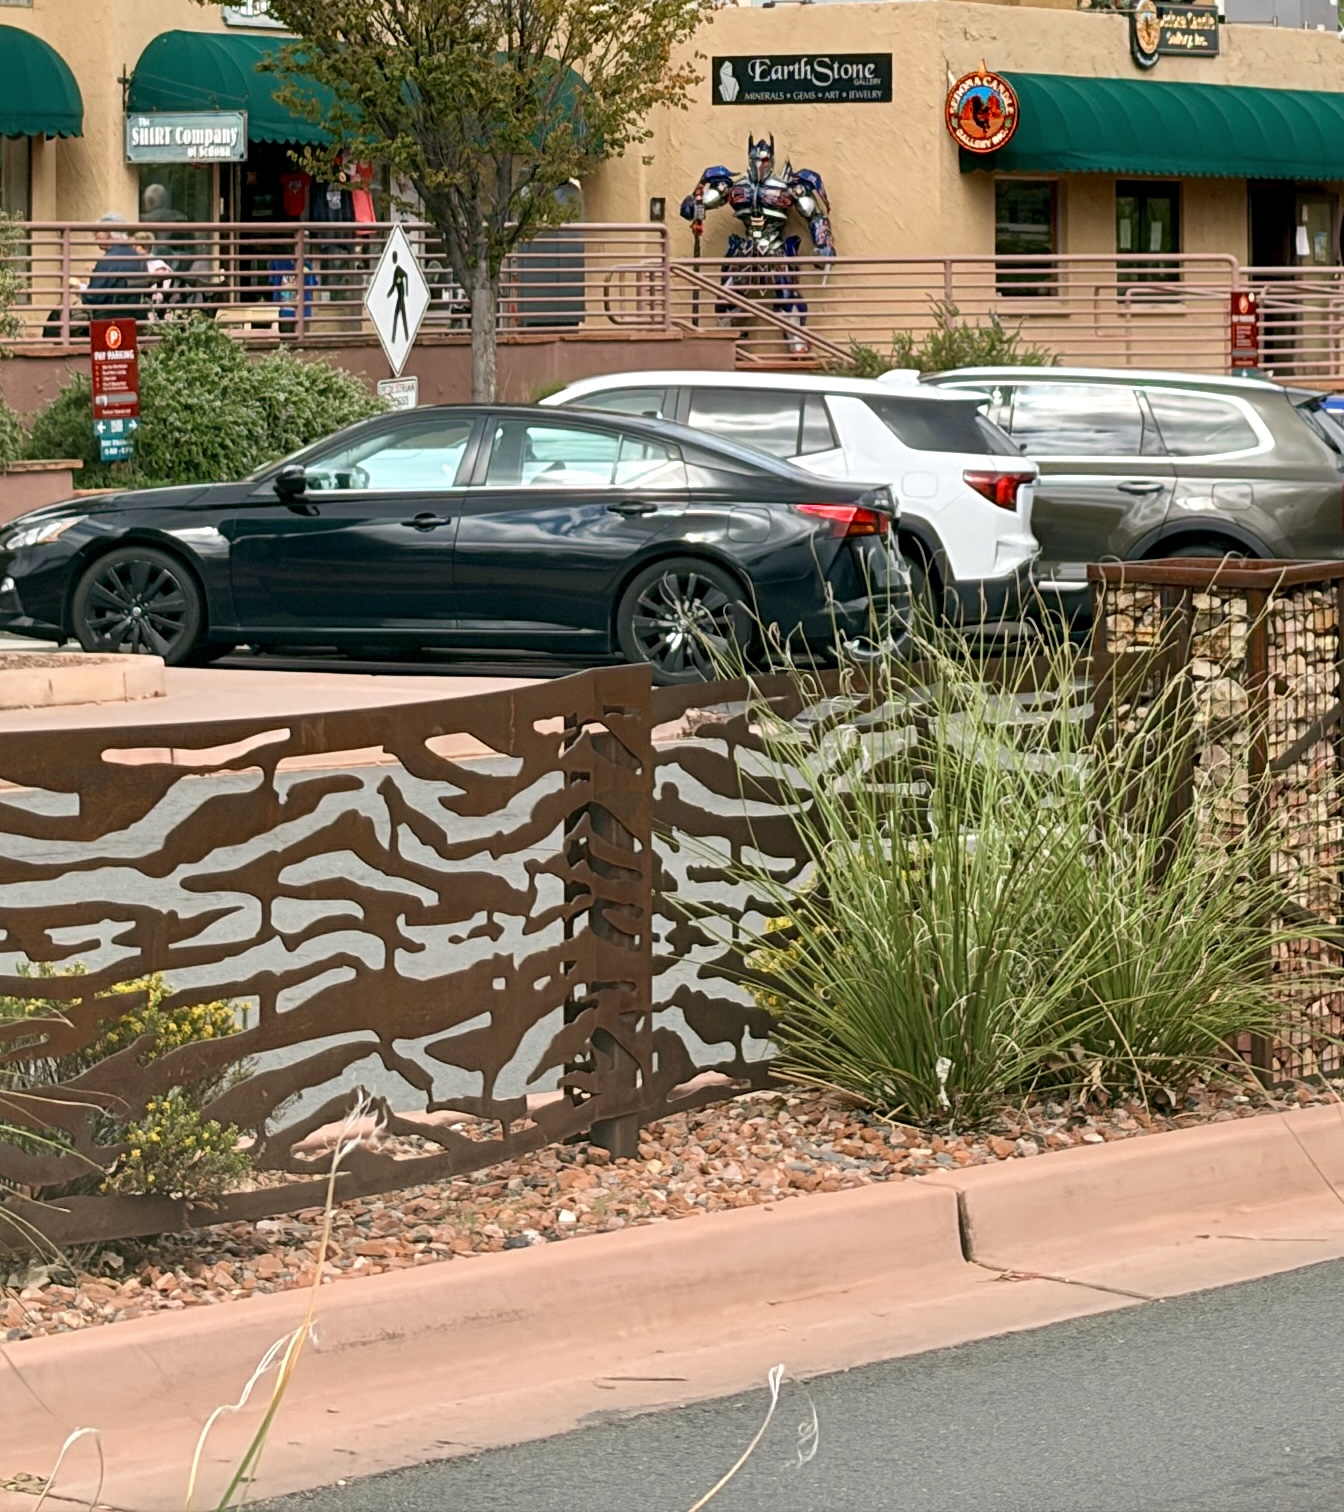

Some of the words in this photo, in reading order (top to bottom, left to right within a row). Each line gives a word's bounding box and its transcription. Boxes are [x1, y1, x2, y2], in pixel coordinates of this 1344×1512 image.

[853, 78, 881, 86] GALLERY
[744, 92, 784, 100] MINERALS
[793, 91, 816, 100] GEMS
[824, 91, 839, 99] ART
[849, 90, 882, 99] JEWELRY
[138, 117, 150, 127] The
[131, 127, 172, 146] SHIRT
[175, 127, 238, 146] Company
